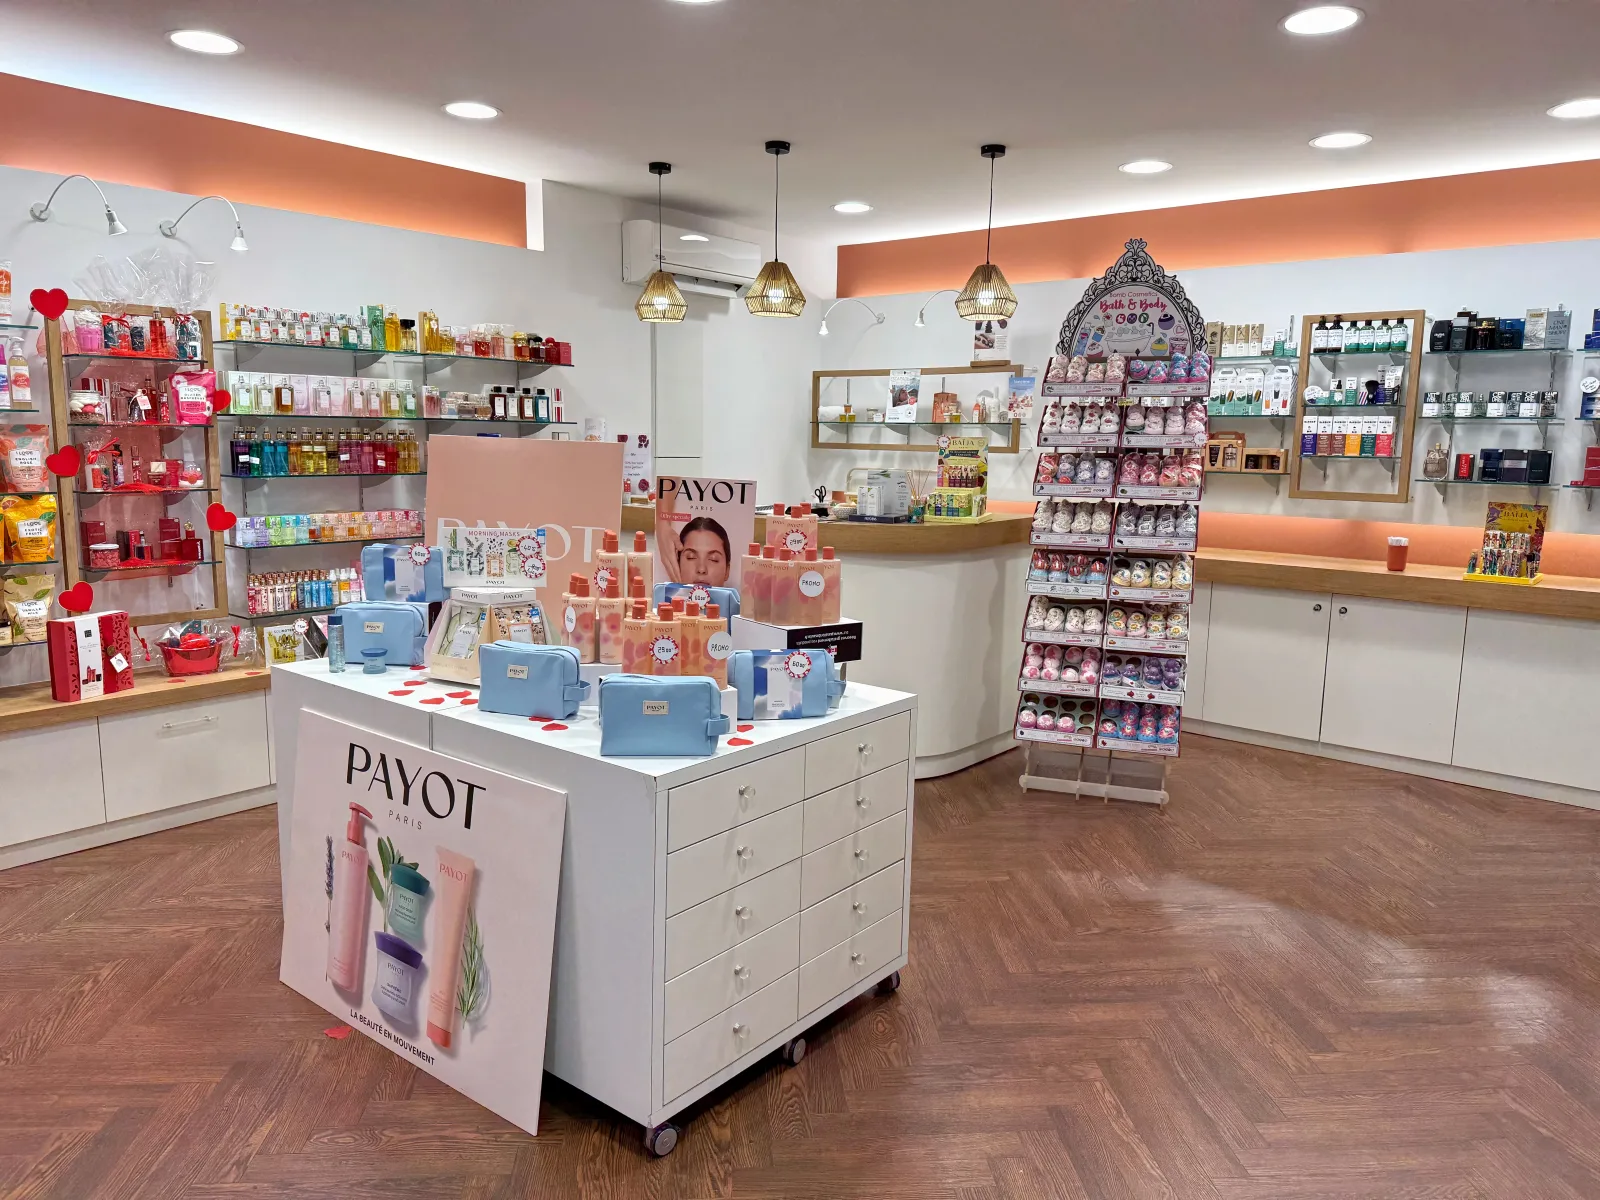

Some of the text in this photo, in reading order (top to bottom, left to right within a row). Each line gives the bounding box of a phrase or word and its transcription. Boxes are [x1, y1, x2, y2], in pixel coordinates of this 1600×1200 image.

[1100, 296, 1168, 313] Bath & Body
[659, 478, 753, 504] PAYOT
[710, 644, 730, 652] PROMO
[346, 742, 486, 830] PAYOT
[388, 810, 422, 830] PARIS
[440, 862, 468, 882] PAYOT
[388, 962, 404, 976] PAYOT
[350, 1008, 436, 1066] LA BEAUTÉ EN MOUVEMENT
